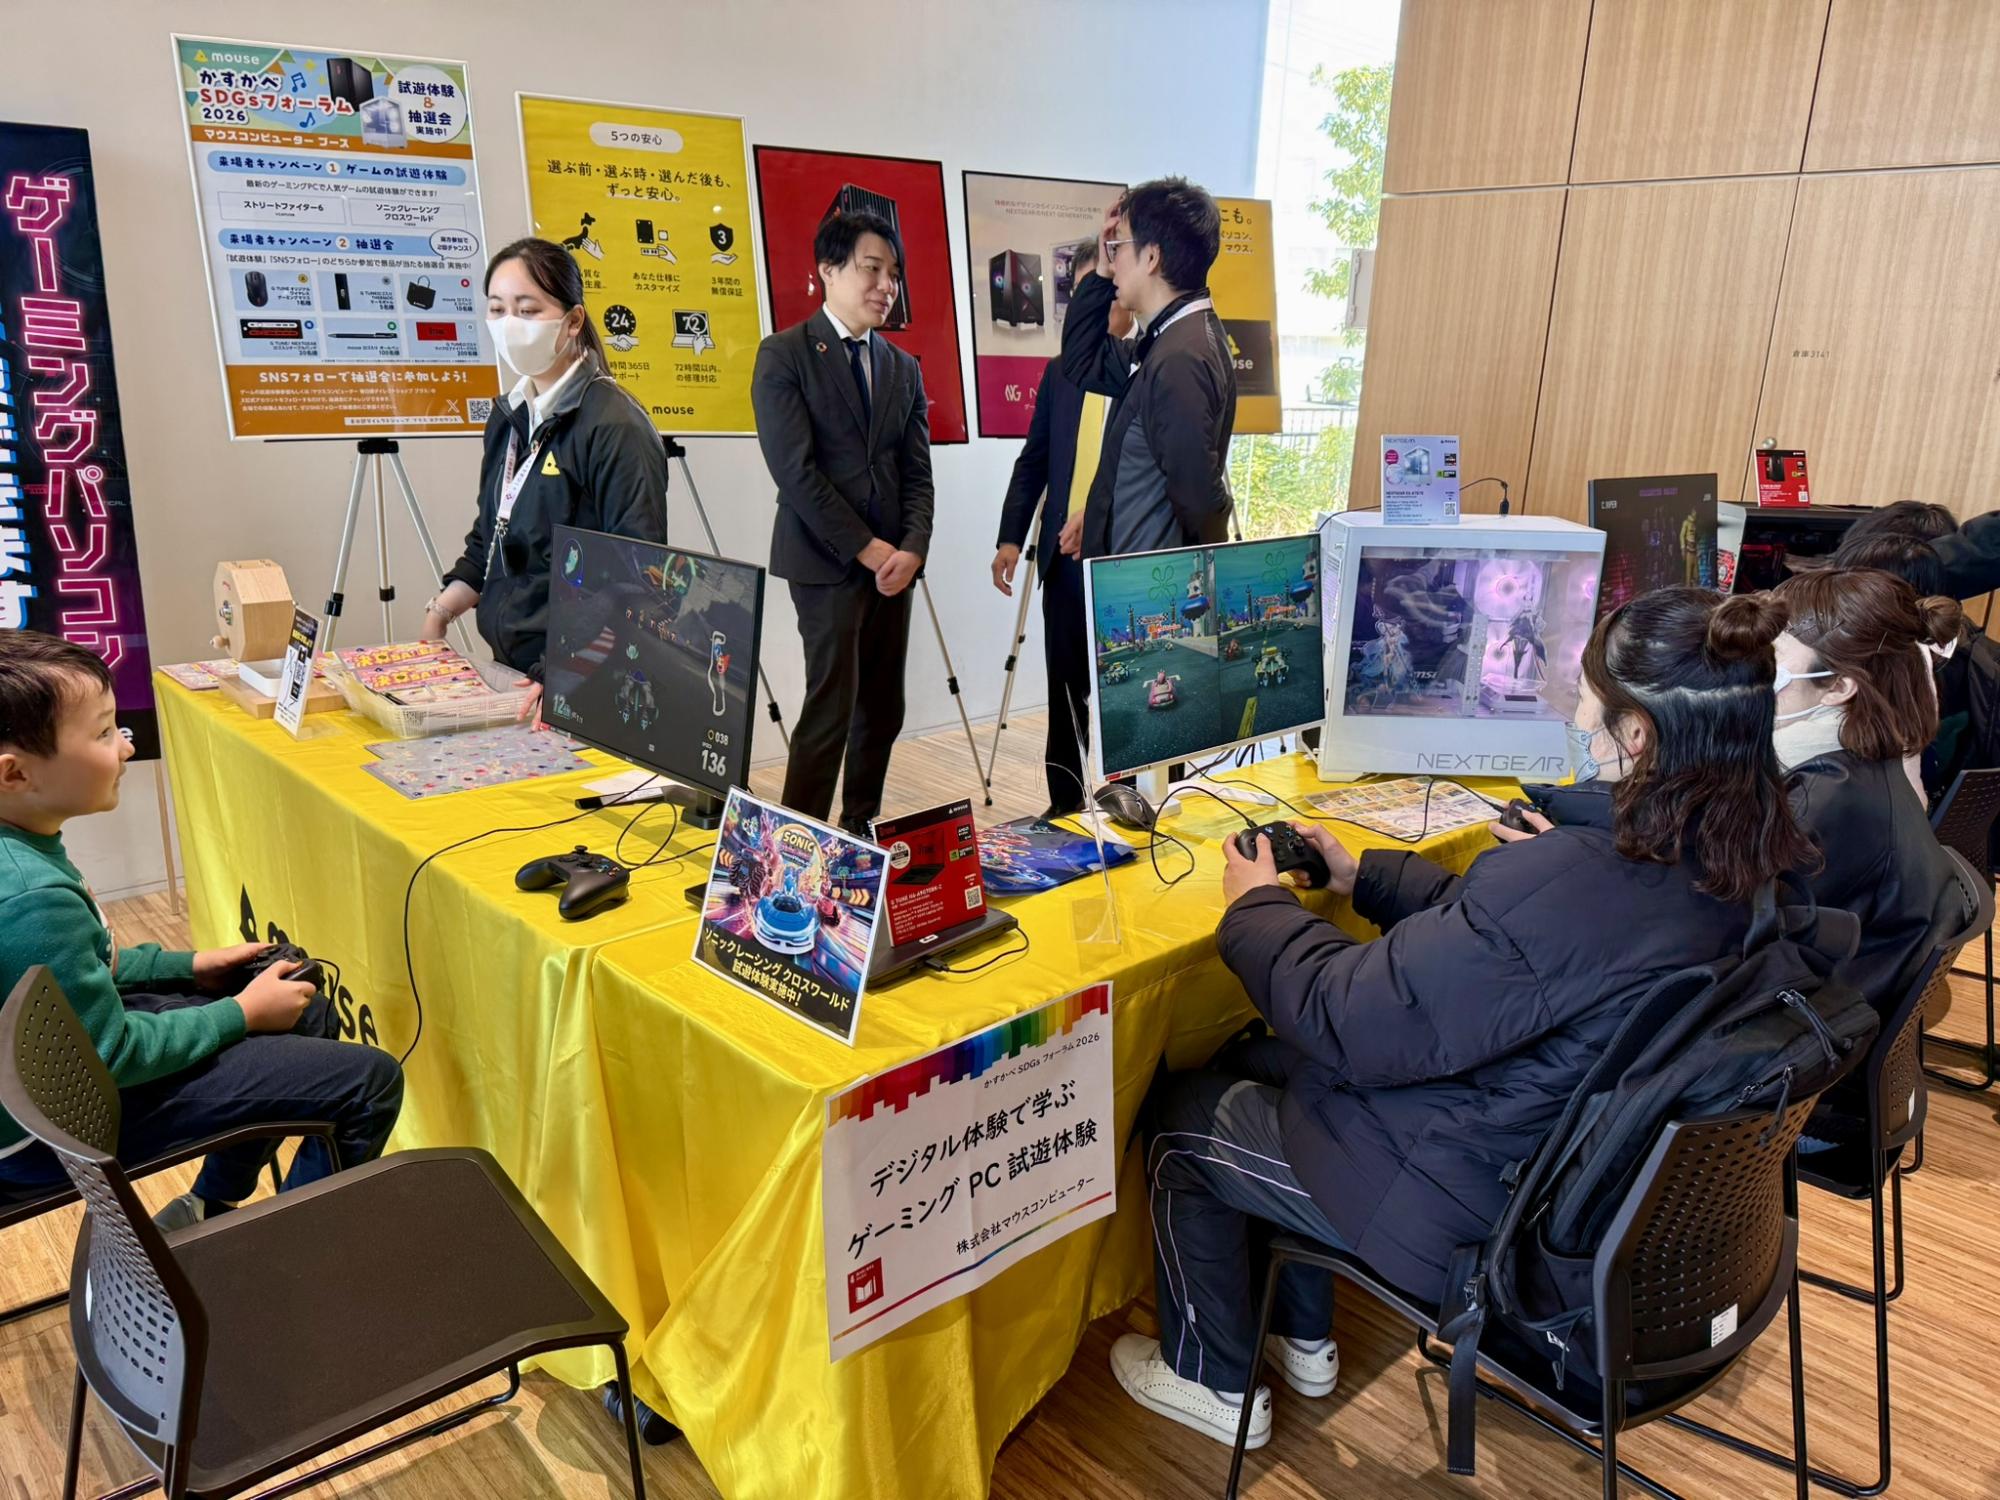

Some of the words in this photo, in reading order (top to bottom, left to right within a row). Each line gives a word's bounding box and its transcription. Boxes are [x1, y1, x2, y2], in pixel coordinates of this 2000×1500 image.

[211, 52, 260, 64] mouse
[200, 71, 279, 88] かすかべ
[398, 81, 455, 98] 試遊体験
[200, 89, 352, 112] SDGsフォーラム
[423, 97, 435, 108] &
[203, 108, 247, 121] 2026
[408, 110, 452, 126] 抽選会
[204, 129, 314, 145] マウスコンピューター
[318, 137, 350, 149] ブース
[611, 131, 663, 146] 5つの安心
[219, 156, 322, 171] 来場者キャンペーン
[346, 164, 448, 181] ゲームの試遊体験
[547, 159, 731, 188] 選ぶ前・選ぶ時・選んだ後も、
[607, 184, 680, 202] ずっと安心。
[244, 200, 325, 212] ストリートファイター6
[376, 203, 440, 214] ソニックレーシング
[384, 213, 434, 222] クロスワールド
[230, 233, 332, 247] 来場者キャンペーン
[339, 238, 347, 248] 2
[356, 239, 394, 251] 抽選会
[718, 230, 726, 244] 3
[633, 272, 680, 282] あなた仕様に
[712, 276, 741, 286] 3年間の
[635, 283, 680, 293] カスタマイズ
[711, 287, 743, 297] 無償保証
[610, 313, 630, 328] 24
[682, 316, 701, 331] 72
[259, 371, 467, 383] SNSフォローで抽選会に参加しよう!
[676, 374, 717, 384] の修理対応
[652, 406, 694, 415] mouse
[7, 176, 122, 668] ゲーミングパソコン
[715, 732, 729, 746] 038
[701, 749, 727, 776] 136
[1416, 752, 1565, 772] NEXTGEAR
[783, 831, 815, 852] SONIC
[705, 927, 782, 976] ソニックレーシング
[783, 969, 850, 1011] クロスワールド
[732, 959, 802, 1007] 試遊体験実施中!
[984, 1069, 1016, 1089] かすかべ
[1017, 1059, 1041, 1075] SDGs
[1042, 1042, 1075, 1065] フォーラム
[1076, 1032, 1101, 1049] 2026
[870, 1079, 1077, 1198] デジタル体験で学ぶ
[847, 1177, 961, 1260] ゲーミング
[969, 1162, 1003, 1199] PC
[1008, 1118, 1099, 1181] 試遊体験
[956, 1176, 1096, 1256] 株式会社マウスコンピューター
